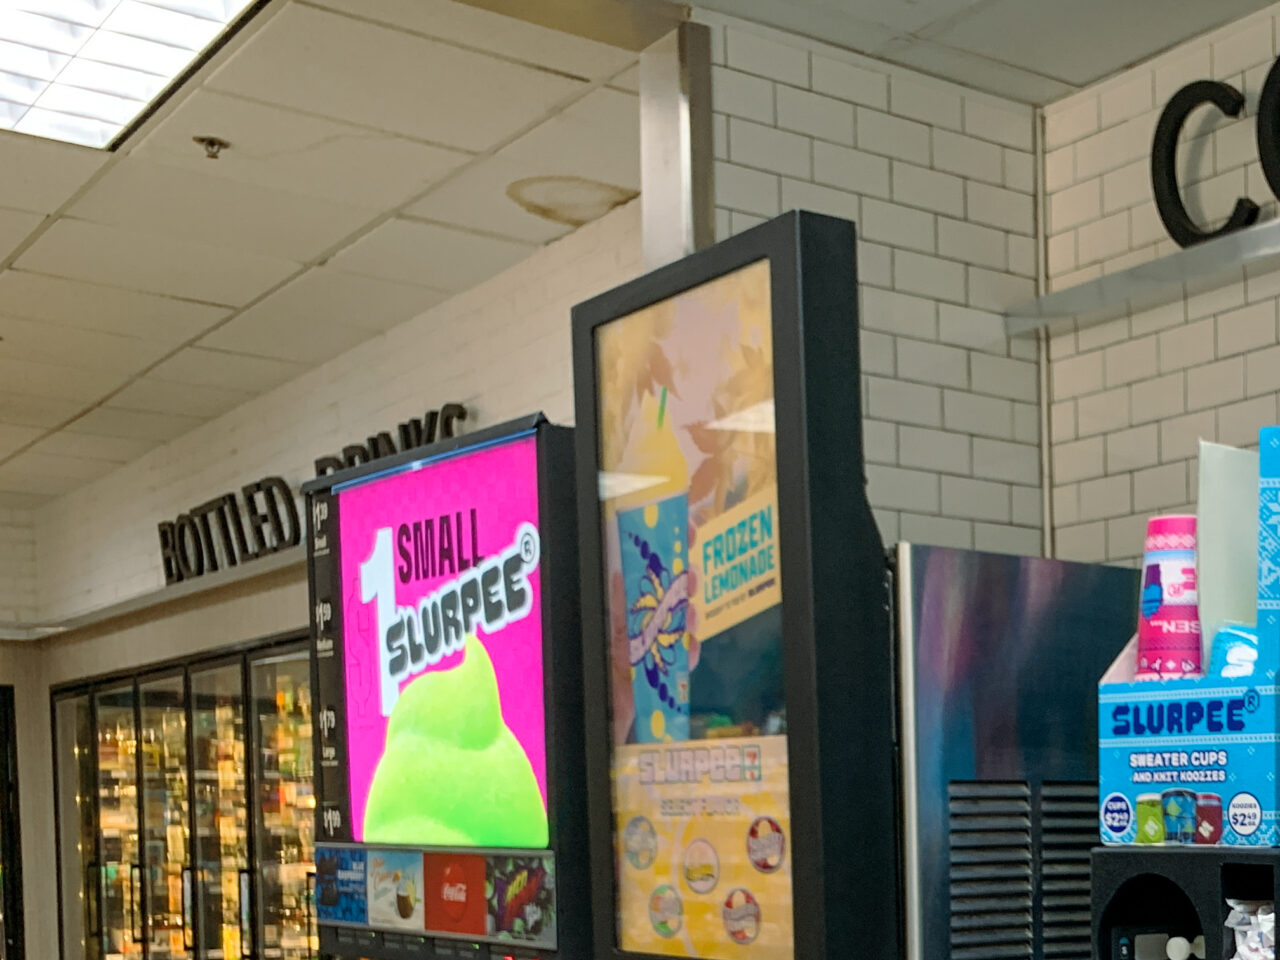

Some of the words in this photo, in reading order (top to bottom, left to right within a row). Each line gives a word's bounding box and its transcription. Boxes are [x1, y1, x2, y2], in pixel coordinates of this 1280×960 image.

[157, 476, 302, 586] BOTTLED
[397, 508, 485, 584] SMALL
[702, 504, 773, 576] FROZEN
[704, 545, 775, 605] LEMONADE
[361, 527, 400, 717] 1
[1129, 751, 1189, 768] SWEATER
[1190, 750, 1228, 766] CUPS
[1132, 772, 1152, 783] AND
[1179, 770, 1226, 782] KOOZIES
